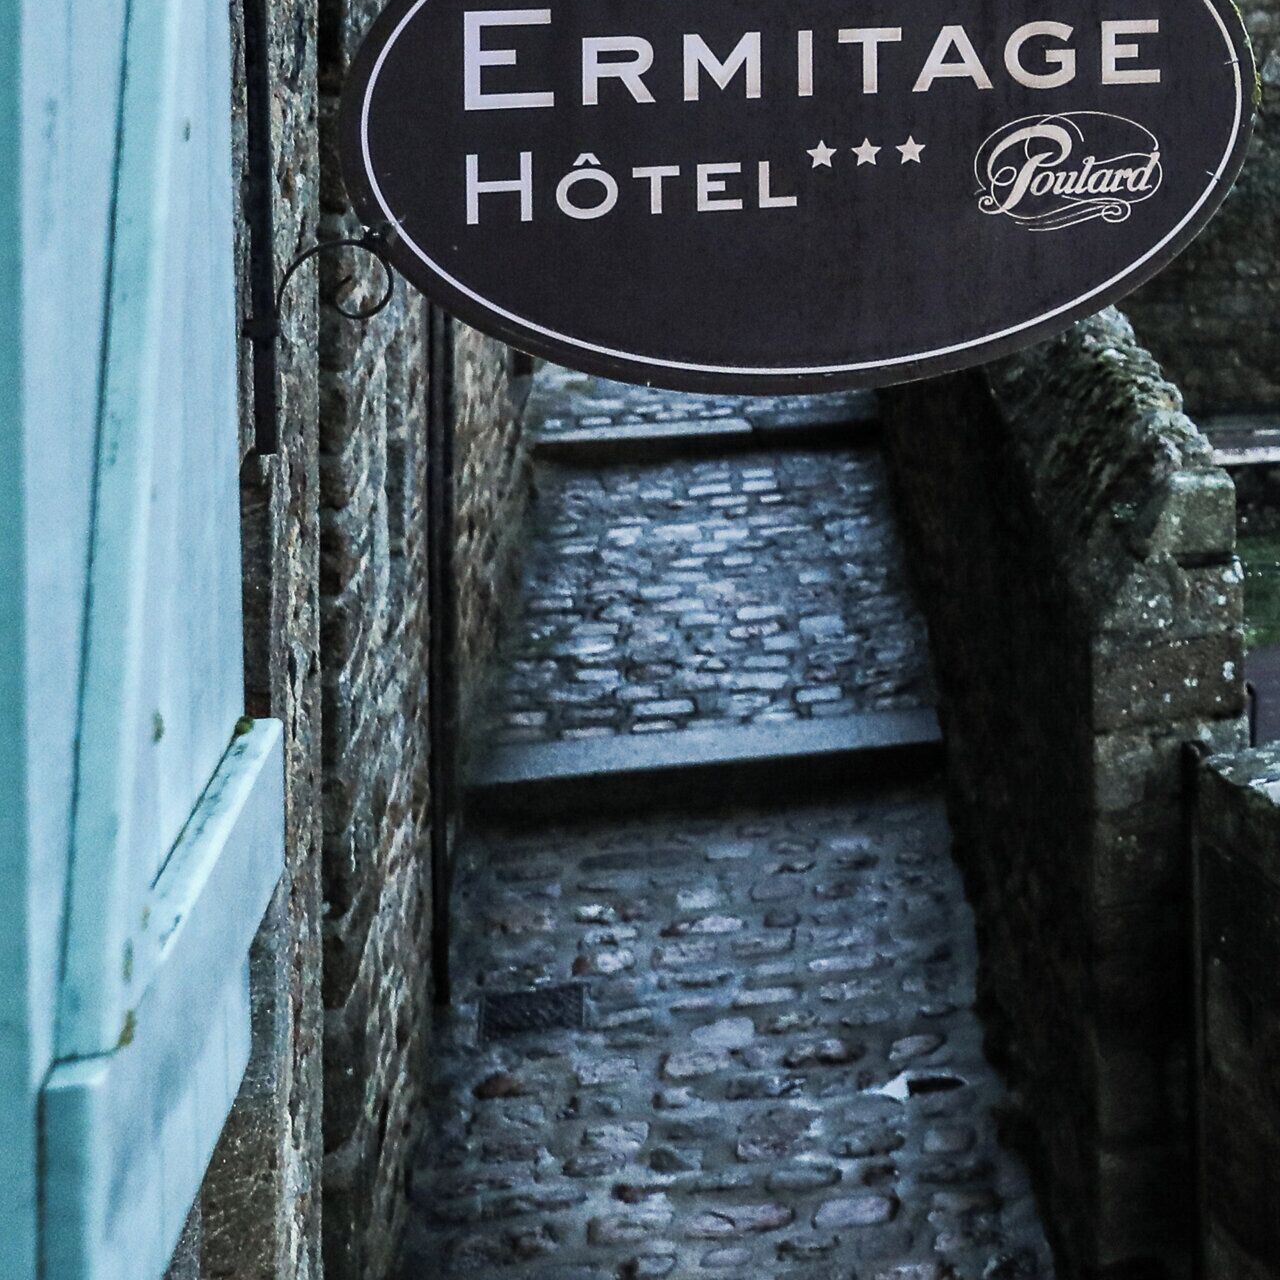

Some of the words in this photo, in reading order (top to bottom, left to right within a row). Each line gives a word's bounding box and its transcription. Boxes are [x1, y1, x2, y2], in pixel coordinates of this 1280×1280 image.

[463, 8, 1161, 111] ERMITAGE
[465, 151, 798, 225] HÔTEL
[981, 122, 1161, 220] Poulard
